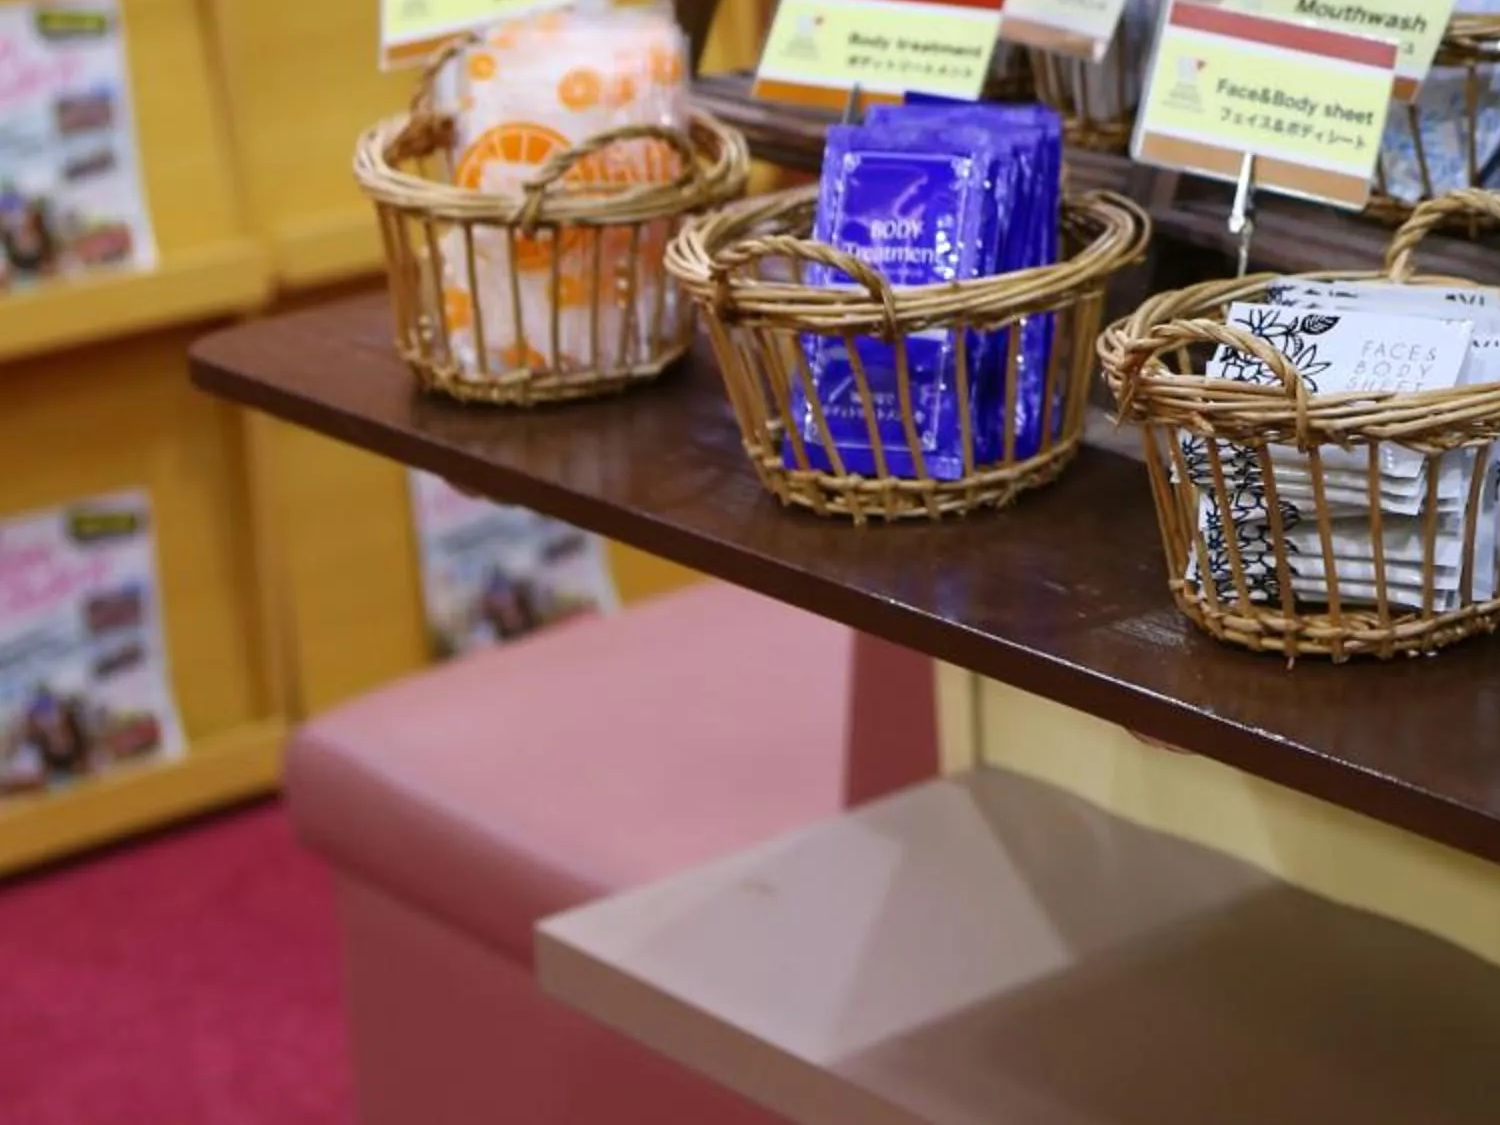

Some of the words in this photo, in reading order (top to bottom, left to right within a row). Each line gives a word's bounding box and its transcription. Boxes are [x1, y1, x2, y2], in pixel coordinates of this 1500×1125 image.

[896, 37, 983, 59] treatment
[1215, 77, 1319, 117] Face&Body
[1323, 100, 1375, 126] sheet
